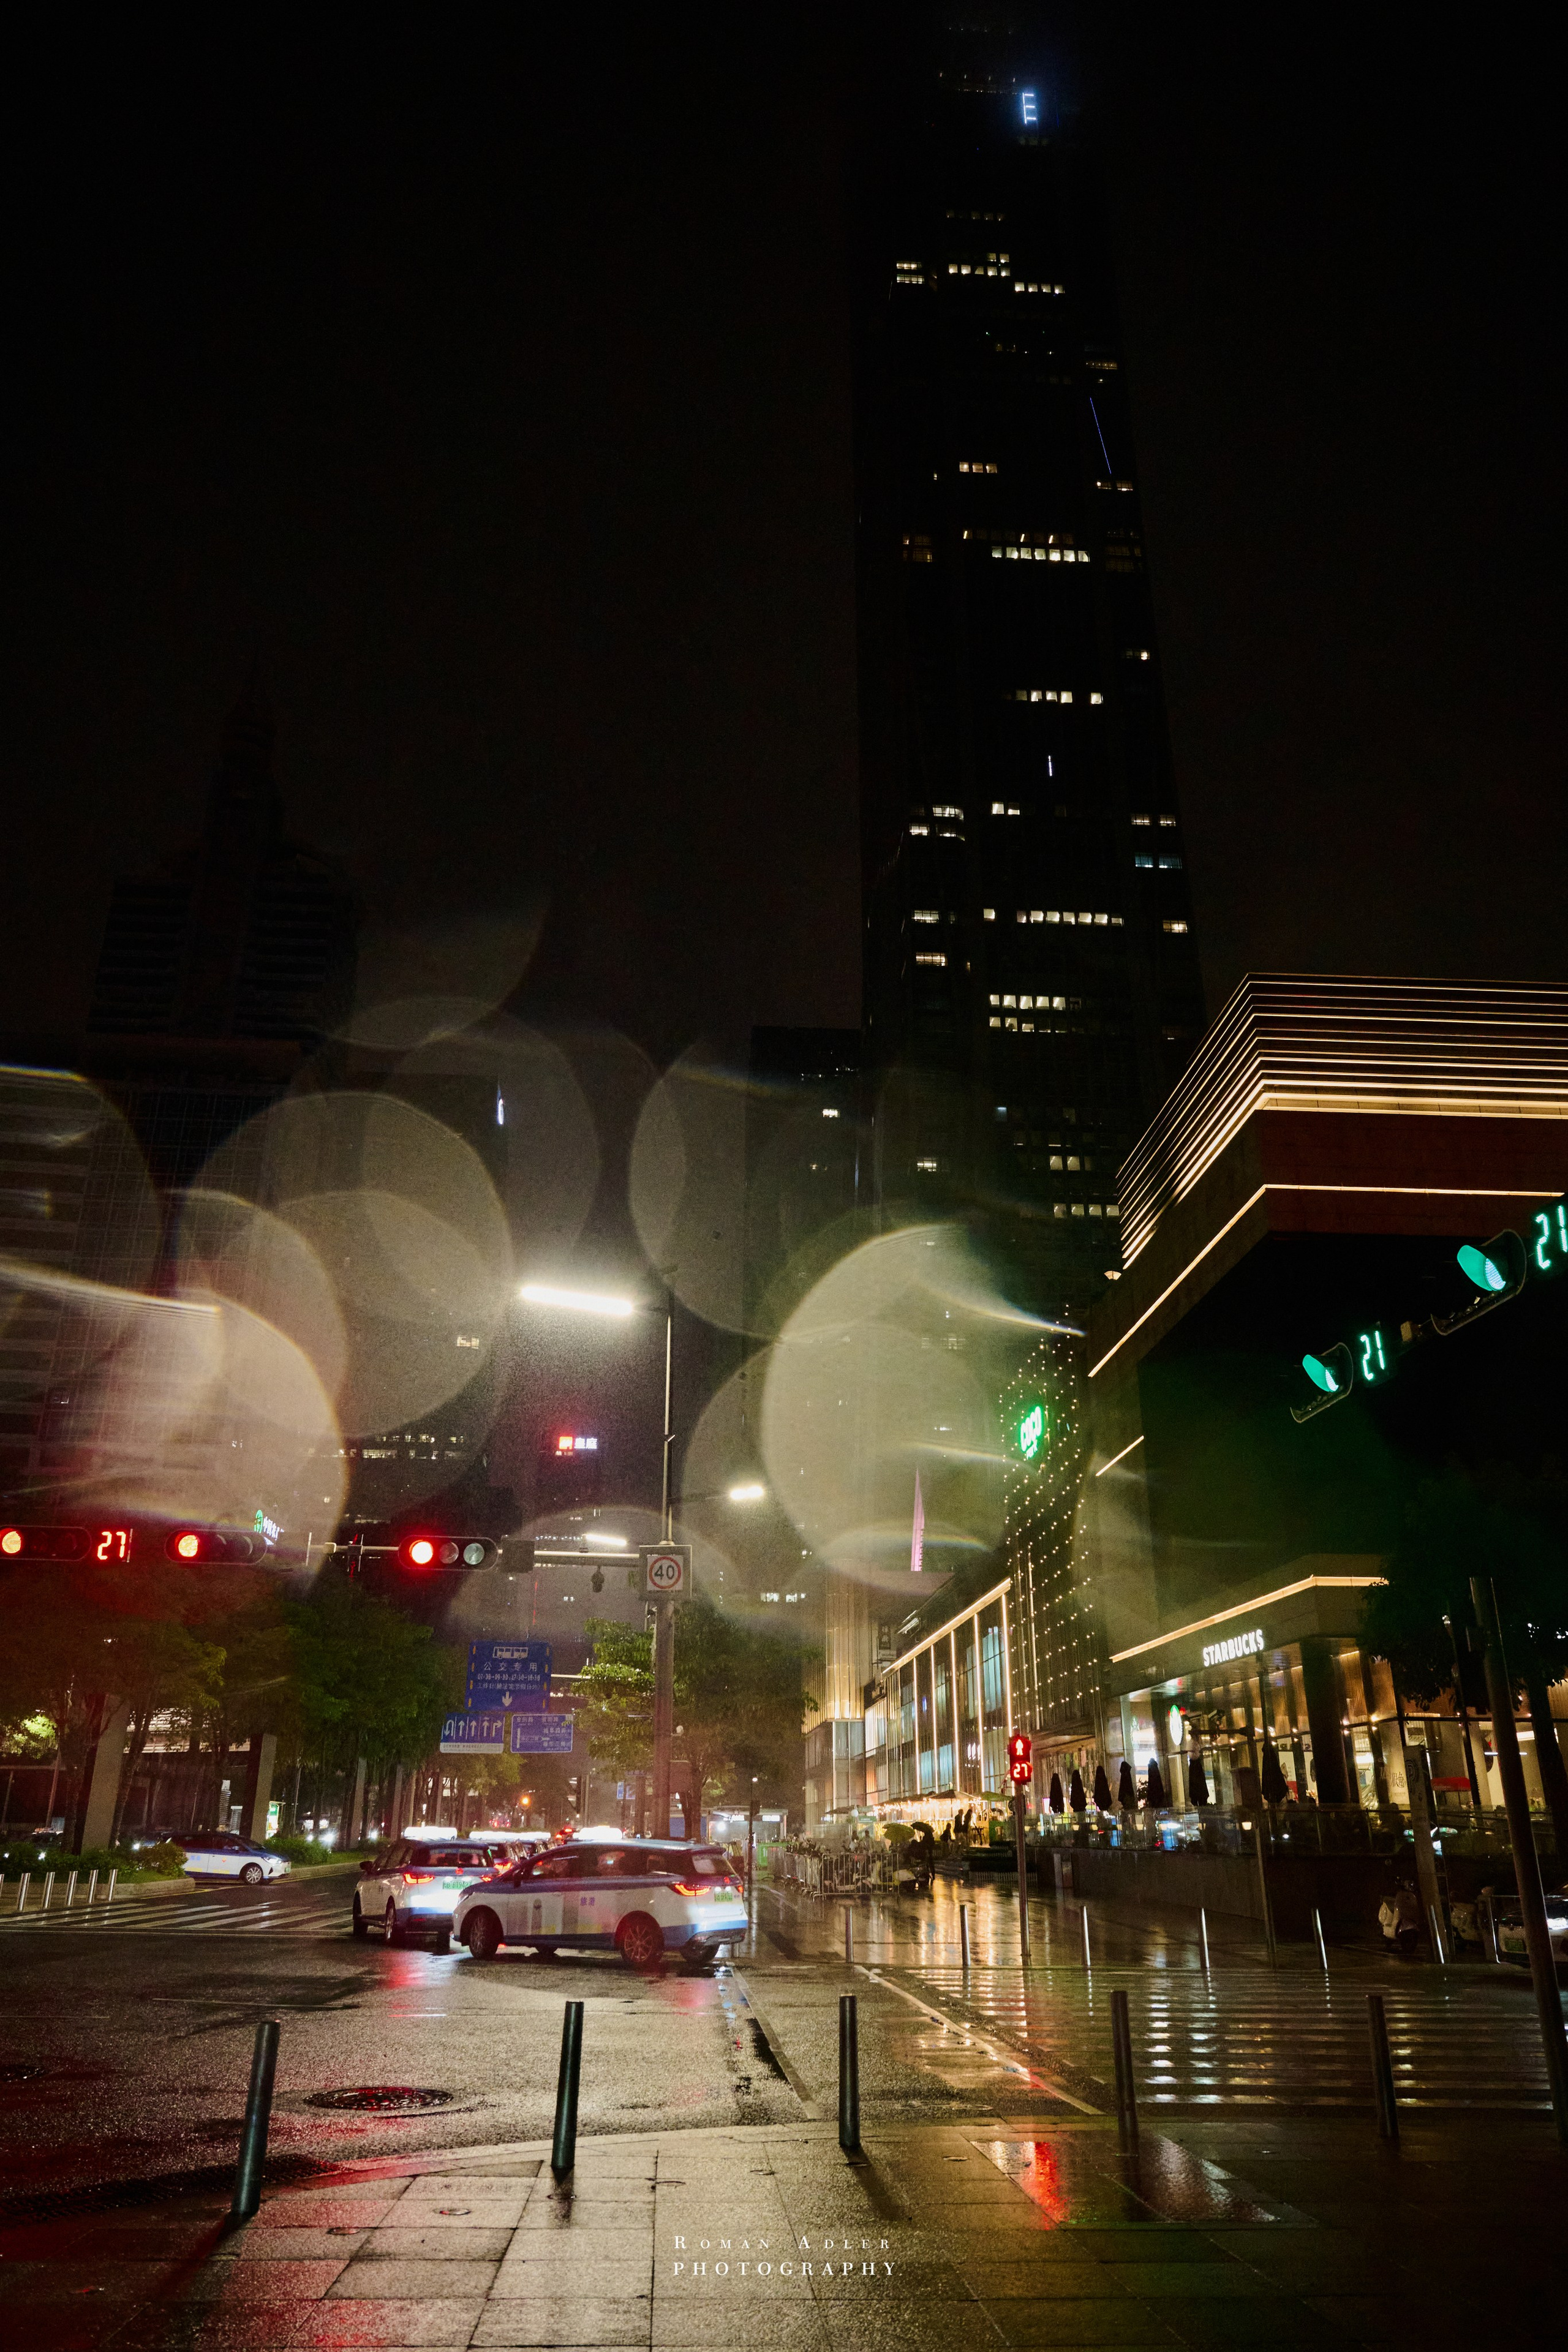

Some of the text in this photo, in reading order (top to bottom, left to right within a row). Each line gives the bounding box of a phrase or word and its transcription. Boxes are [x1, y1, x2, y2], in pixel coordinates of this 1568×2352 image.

[1022, 92, 1036, 124] E
[1536, 1205, 1568, 1270] 21
[1360, 1331, 1385, 1381] 21
[97, 1531, 126, 1560] 27
[654, 1564, 675, 1580] 40
[1203, 1629, 1264, 1667] STARBUCKS
[483, 1661, 538, 1672] 公交专用
[1014, 1763, 1028, 1778] 27
